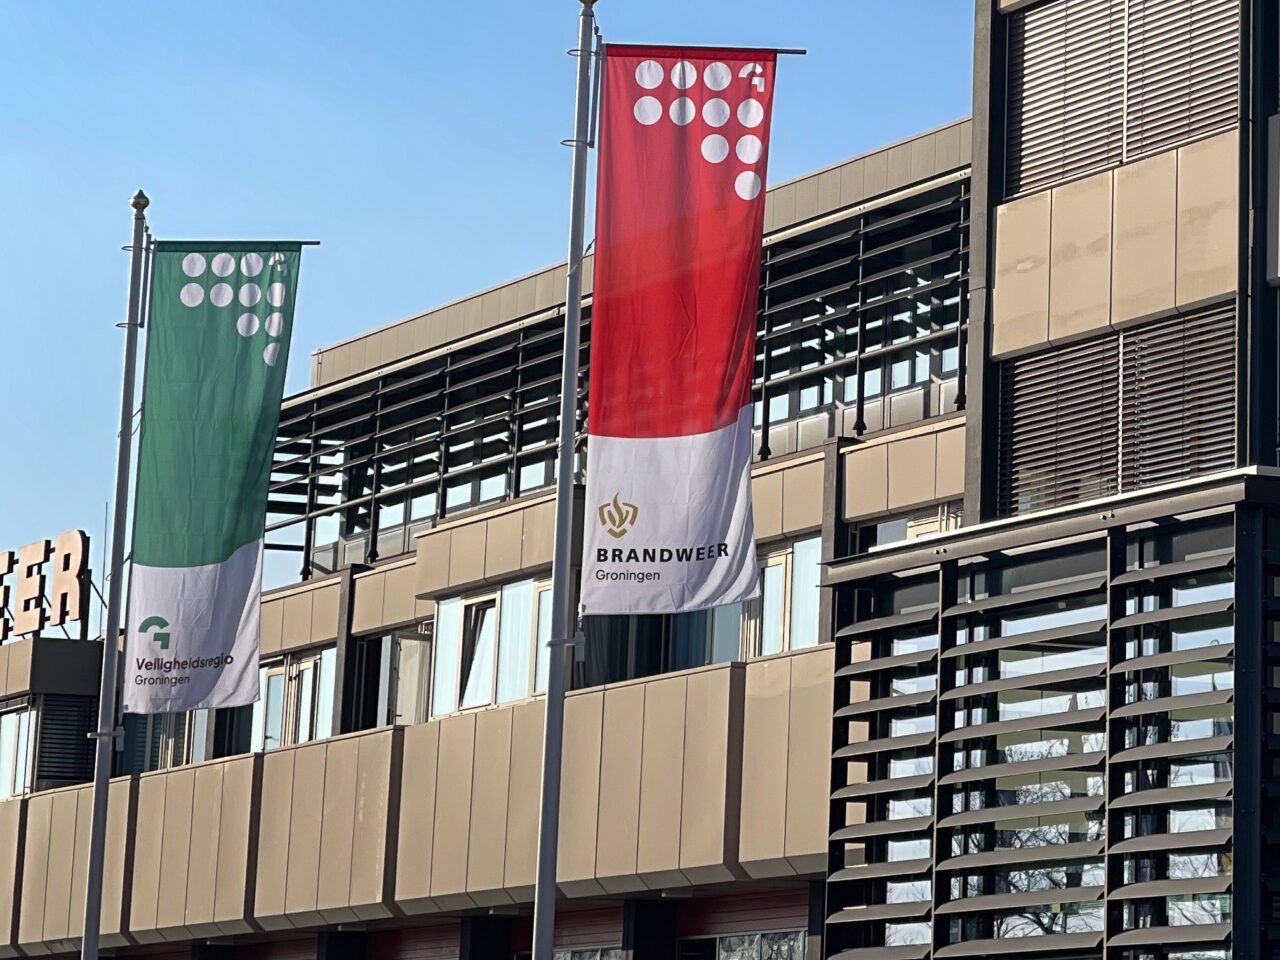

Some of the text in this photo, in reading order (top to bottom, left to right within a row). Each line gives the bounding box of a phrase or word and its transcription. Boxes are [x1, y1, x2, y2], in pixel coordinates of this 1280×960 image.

[596, 542, 729, 563] BRANDWEER
[595, 569, 660, 583] Groningen
[136, 652, 234, 673] Veiligheidsregio
[134, 674, 190, 687] Groningen
